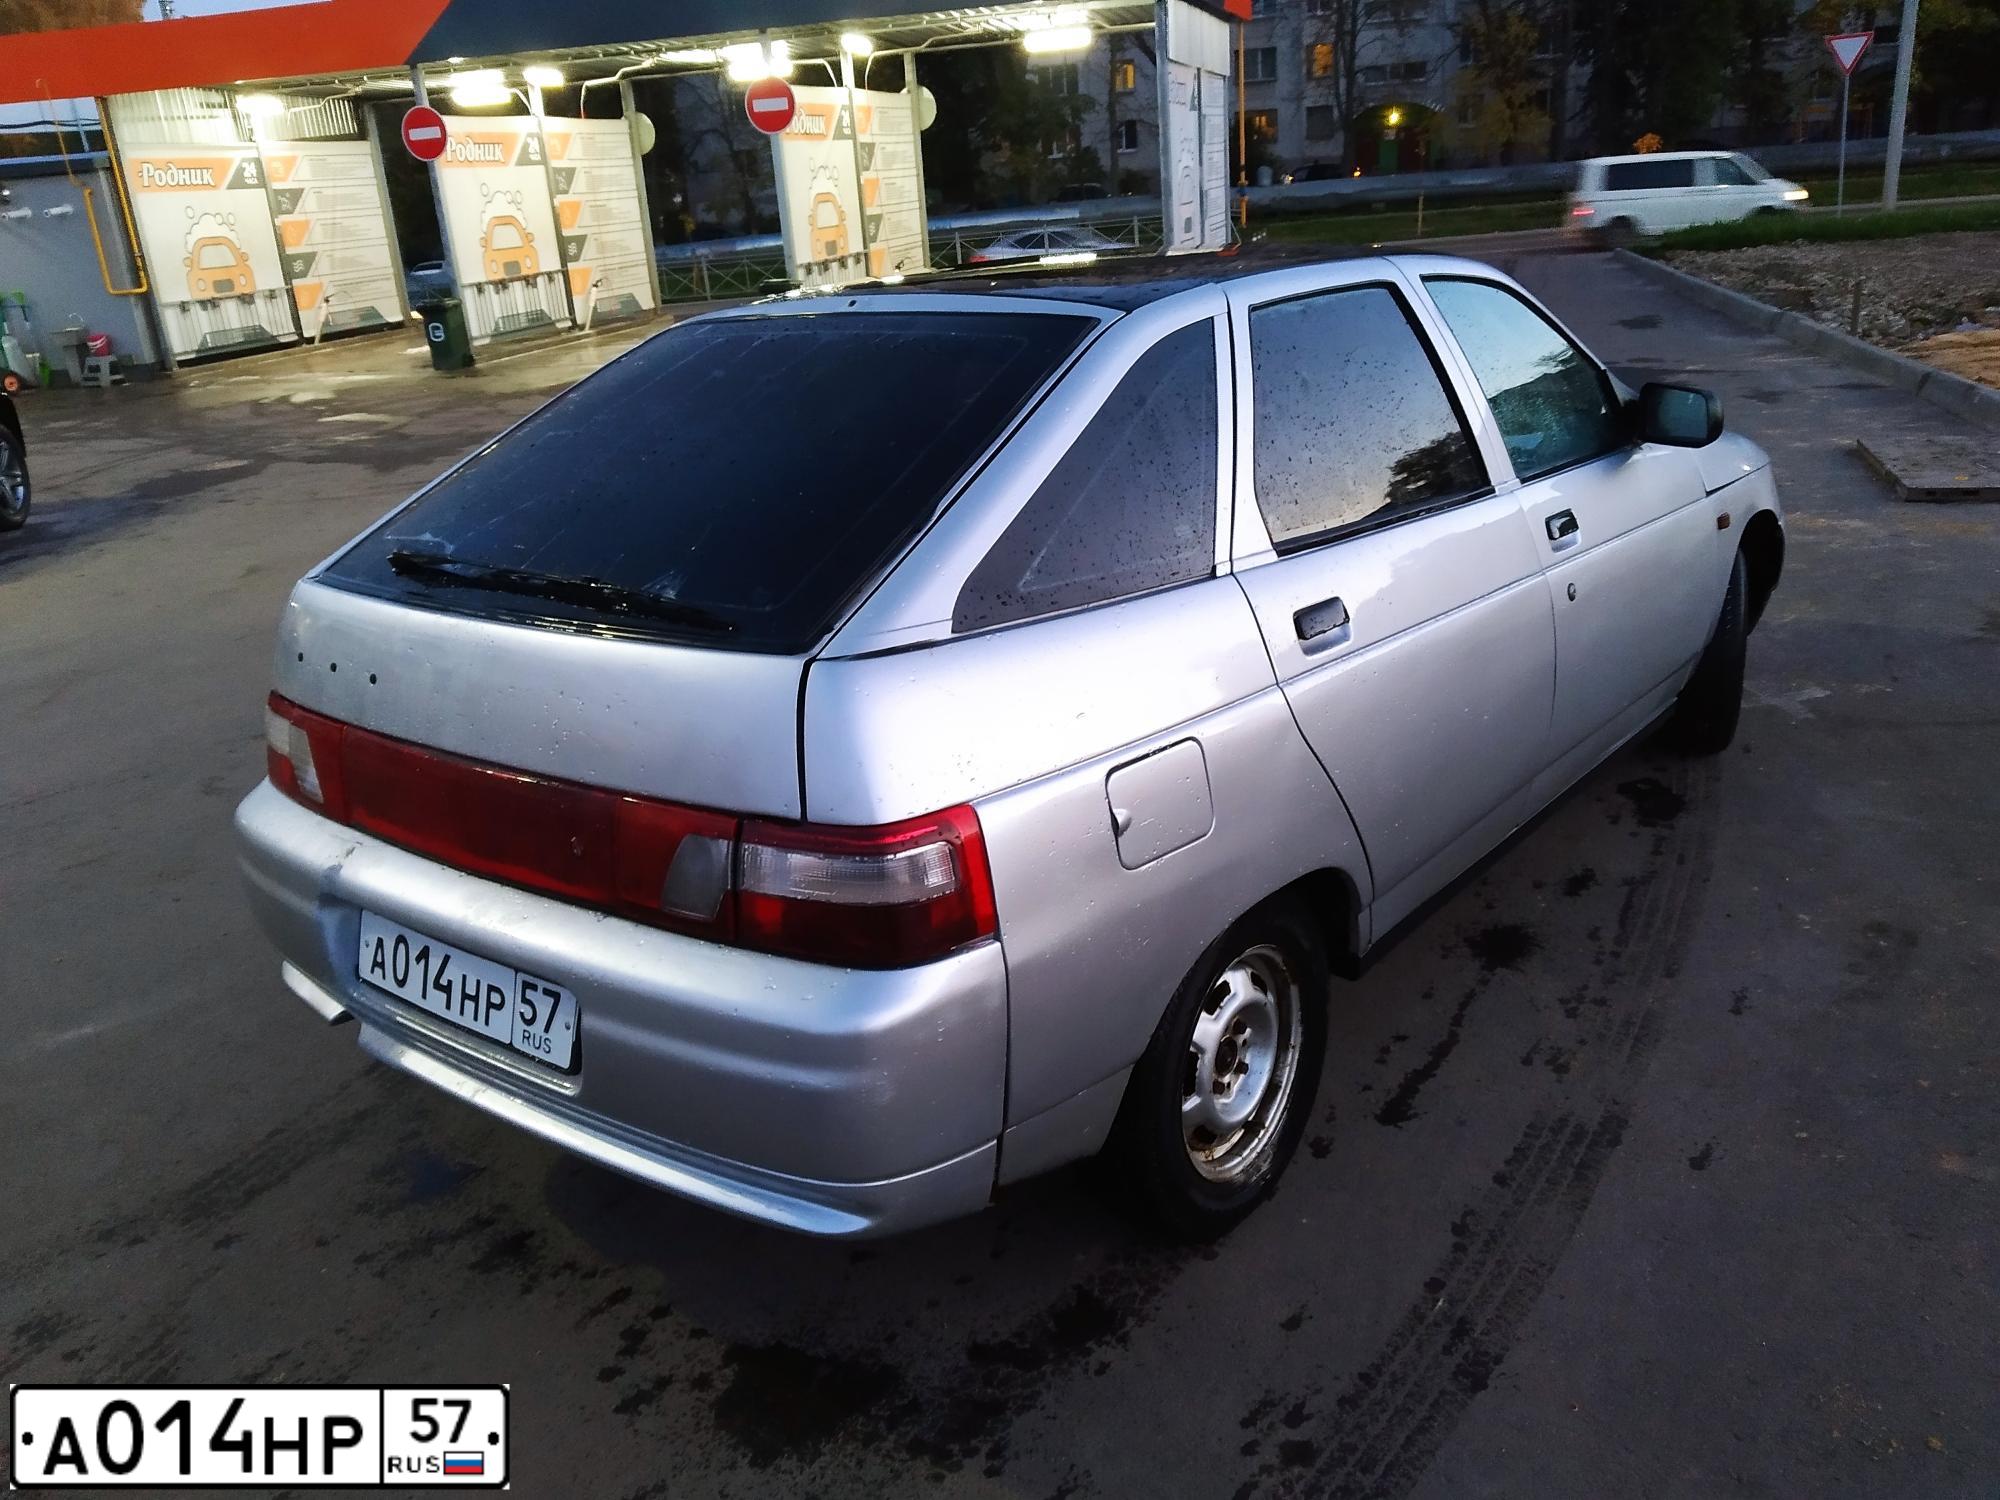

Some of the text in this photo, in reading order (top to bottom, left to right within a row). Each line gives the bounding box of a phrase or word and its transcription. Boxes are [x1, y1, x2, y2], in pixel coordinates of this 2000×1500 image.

[445, 135, 505, 163] Родник
[138, 161, 216, 188] Родник
[241, 161, 257, 177] 24
[370, 934, 506, 1027] А014НР
[515, 979, 562, 1034] 57
[521, 1031, 553, 1055] RUS
